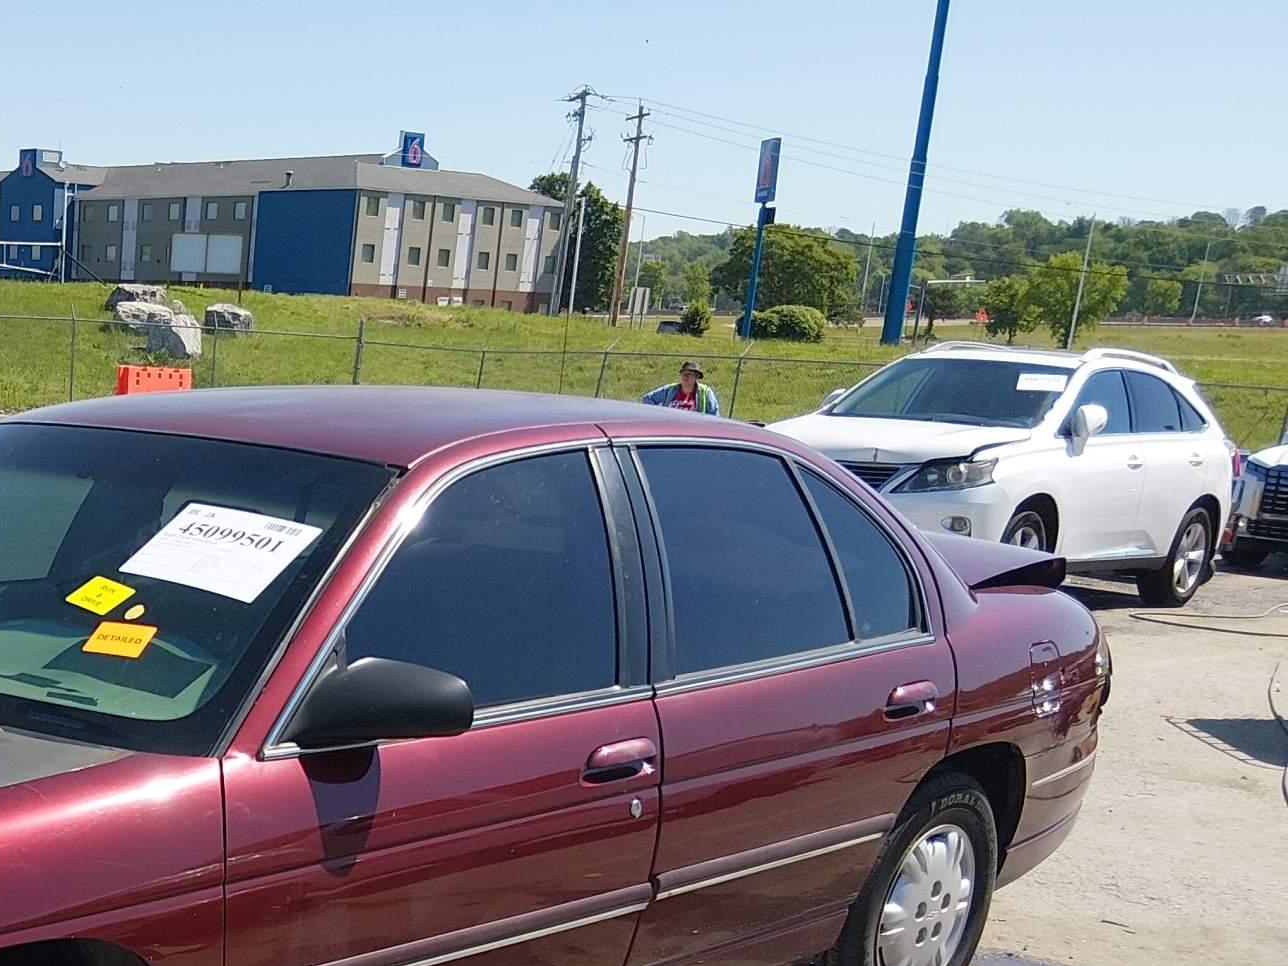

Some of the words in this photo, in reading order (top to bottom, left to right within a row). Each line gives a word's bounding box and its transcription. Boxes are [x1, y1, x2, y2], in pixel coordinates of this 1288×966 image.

[408, 138, 421, 165] 6
[178, 521, 285, 554] 45099501
[96, 633, 143, 646] DETAILED
